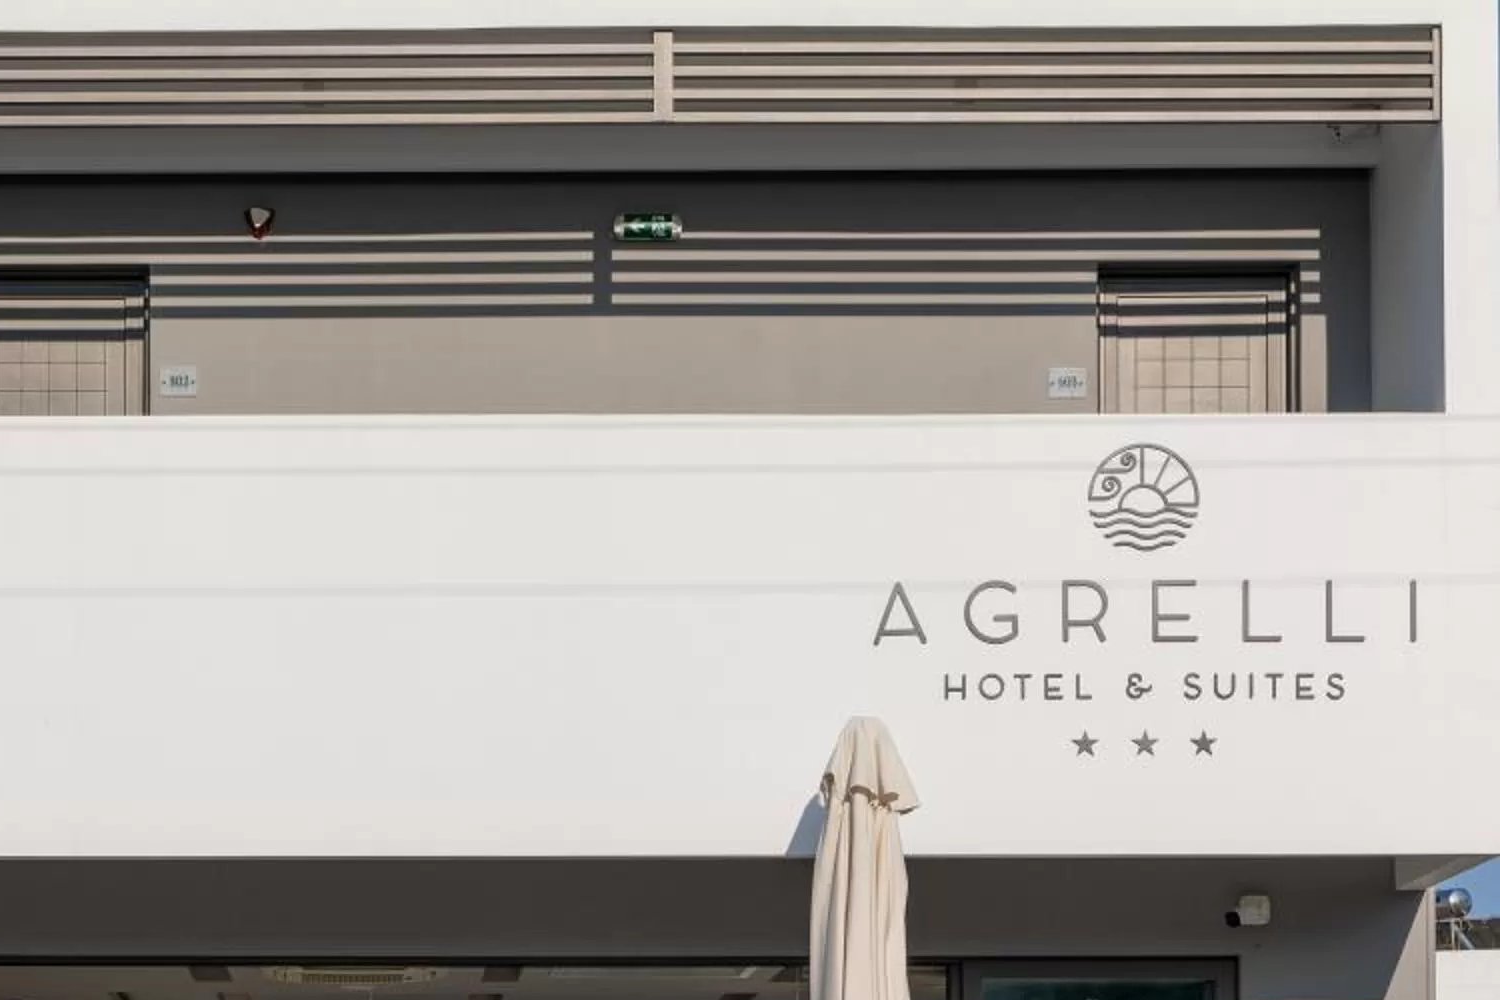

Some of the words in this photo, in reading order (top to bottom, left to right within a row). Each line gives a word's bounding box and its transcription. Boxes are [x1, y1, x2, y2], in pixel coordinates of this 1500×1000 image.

[873, 579, 1417, 647] AGRELLI
[943, 672, 1093, 701] HOTEL
[1125, 672, 1153, 700] &
[1183, 672, 1346, 701] SUITES
